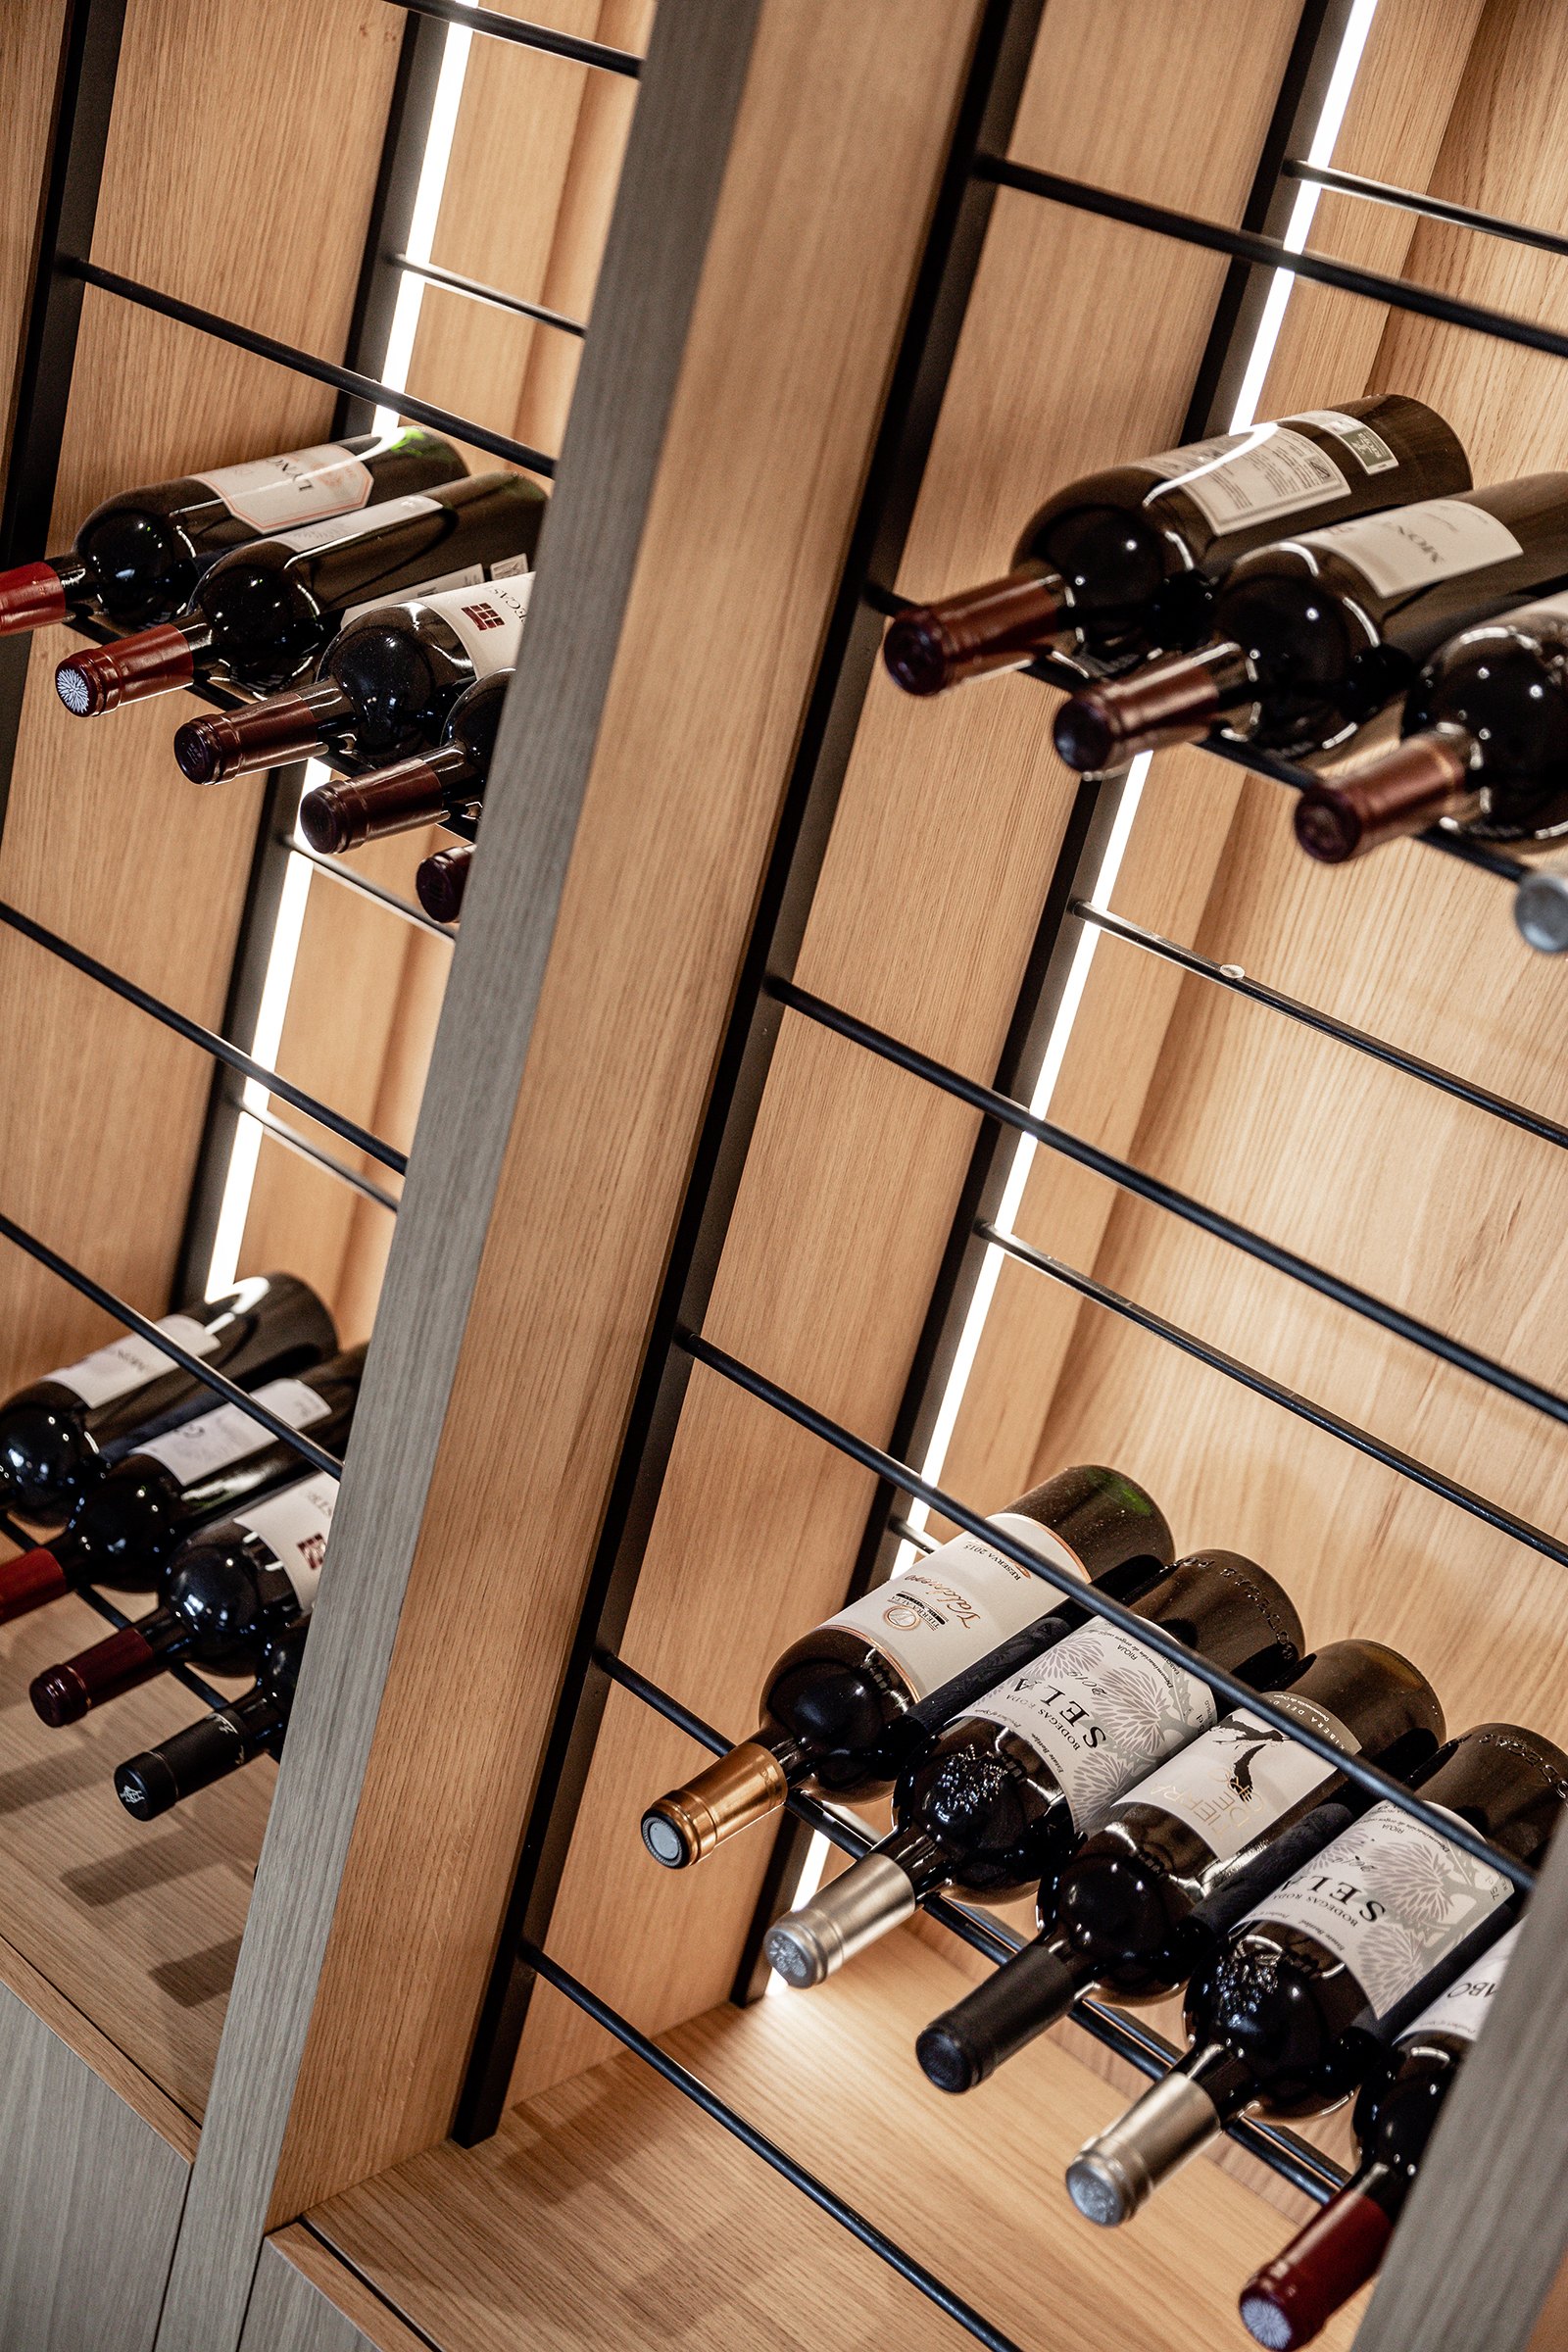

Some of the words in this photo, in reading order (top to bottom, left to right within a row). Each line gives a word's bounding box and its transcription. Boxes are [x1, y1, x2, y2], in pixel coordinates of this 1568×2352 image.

[988, 1552, 1021, 1581] RESERVA
[910, 1604, 938, 1629] TIERRA
[1116, 1644, 1138, 1660] RIOJA
[1005, 1691, 1036, 1709] RODA
[1011, 1675, 1106, 1749] SELA
[1037, 1707, 1081, 1750] BODEGAS
[1048, 1751, 1064, 1773] Estate
[1149, 1779, 1230, 1838] TIERRA
[1210, 1790, 1250, 1827] DE
[1382, 1823, 1404, 1834] RIOJA
[1281, 1875, 1385, 1924] SELA
[1489, 1886, 1499, 1900] 75
[1305, 1896, 1358, 1926] BODEGAS
